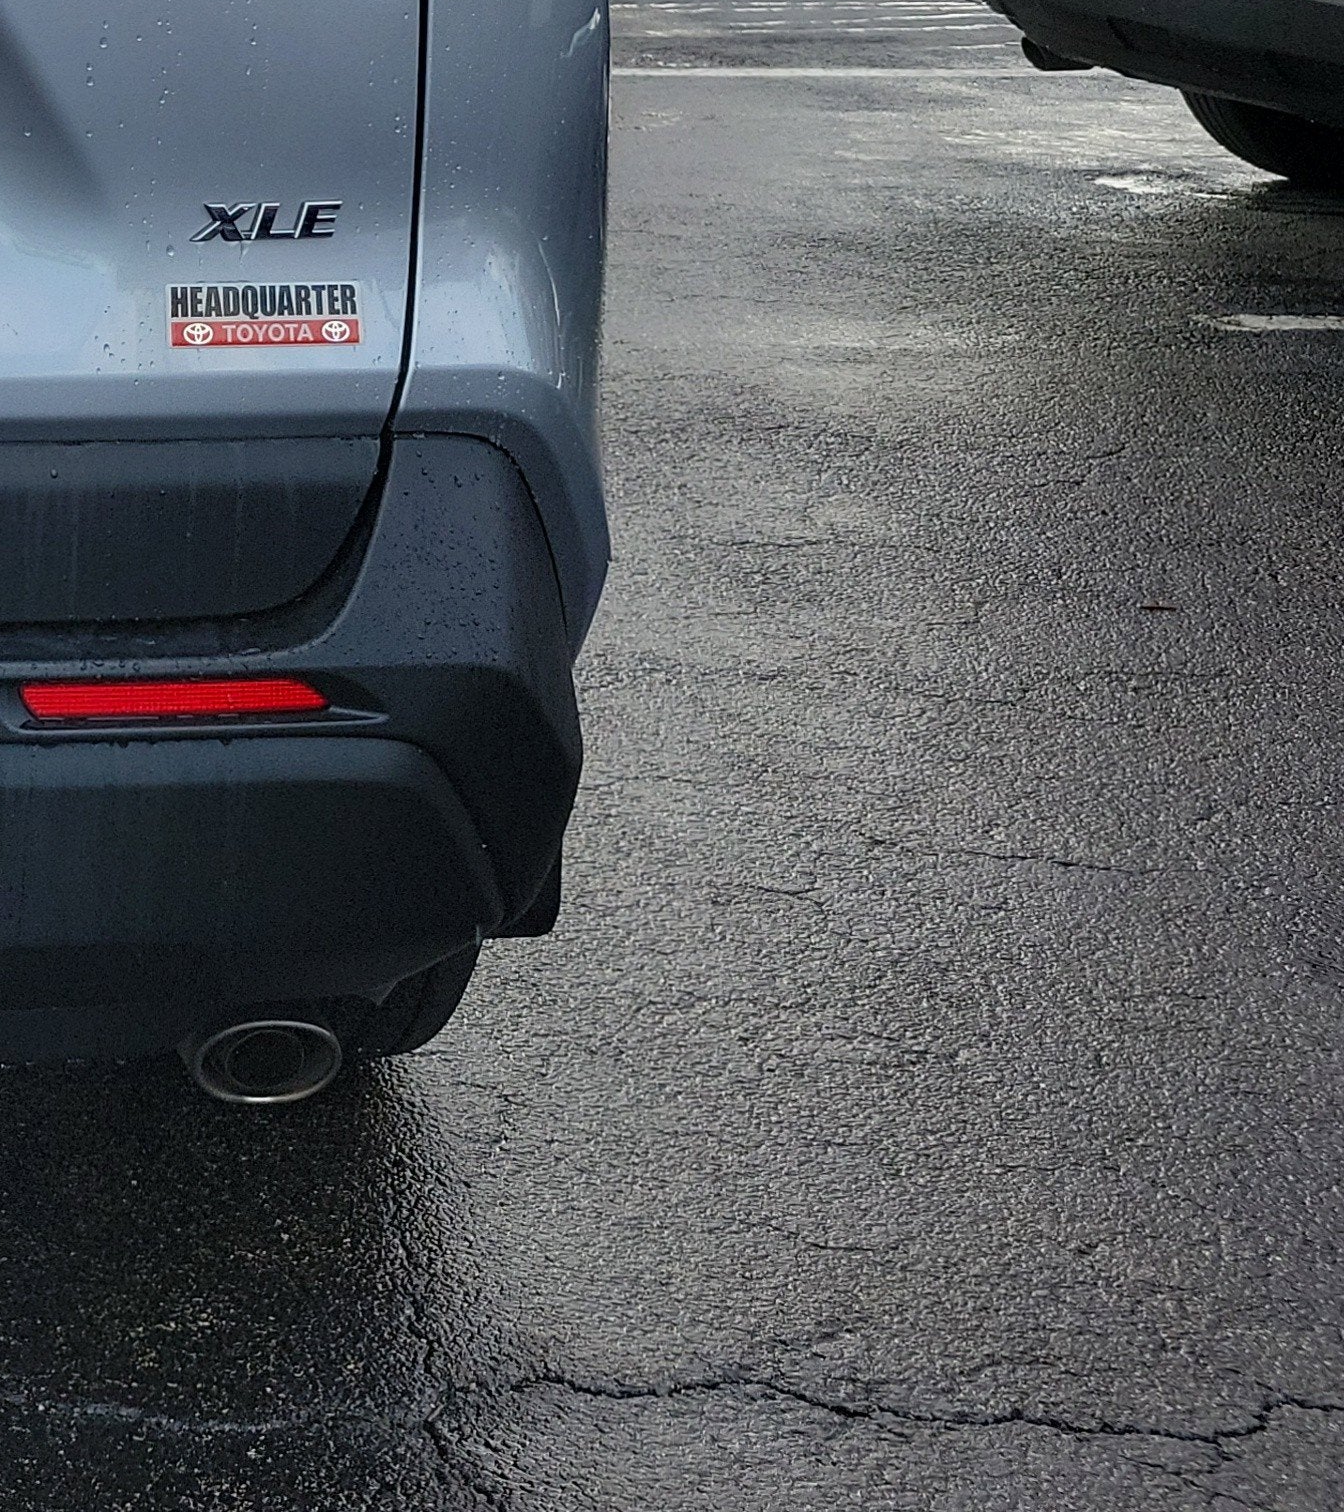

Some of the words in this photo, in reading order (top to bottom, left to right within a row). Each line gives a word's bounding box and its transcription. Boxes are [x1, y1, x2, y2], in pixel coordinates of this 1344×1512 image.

[189, 199, 343, 242] XLE
[169, 284, 358, 320] HEADQUARTER
[221, 322, 314, 343] TOYOTA
